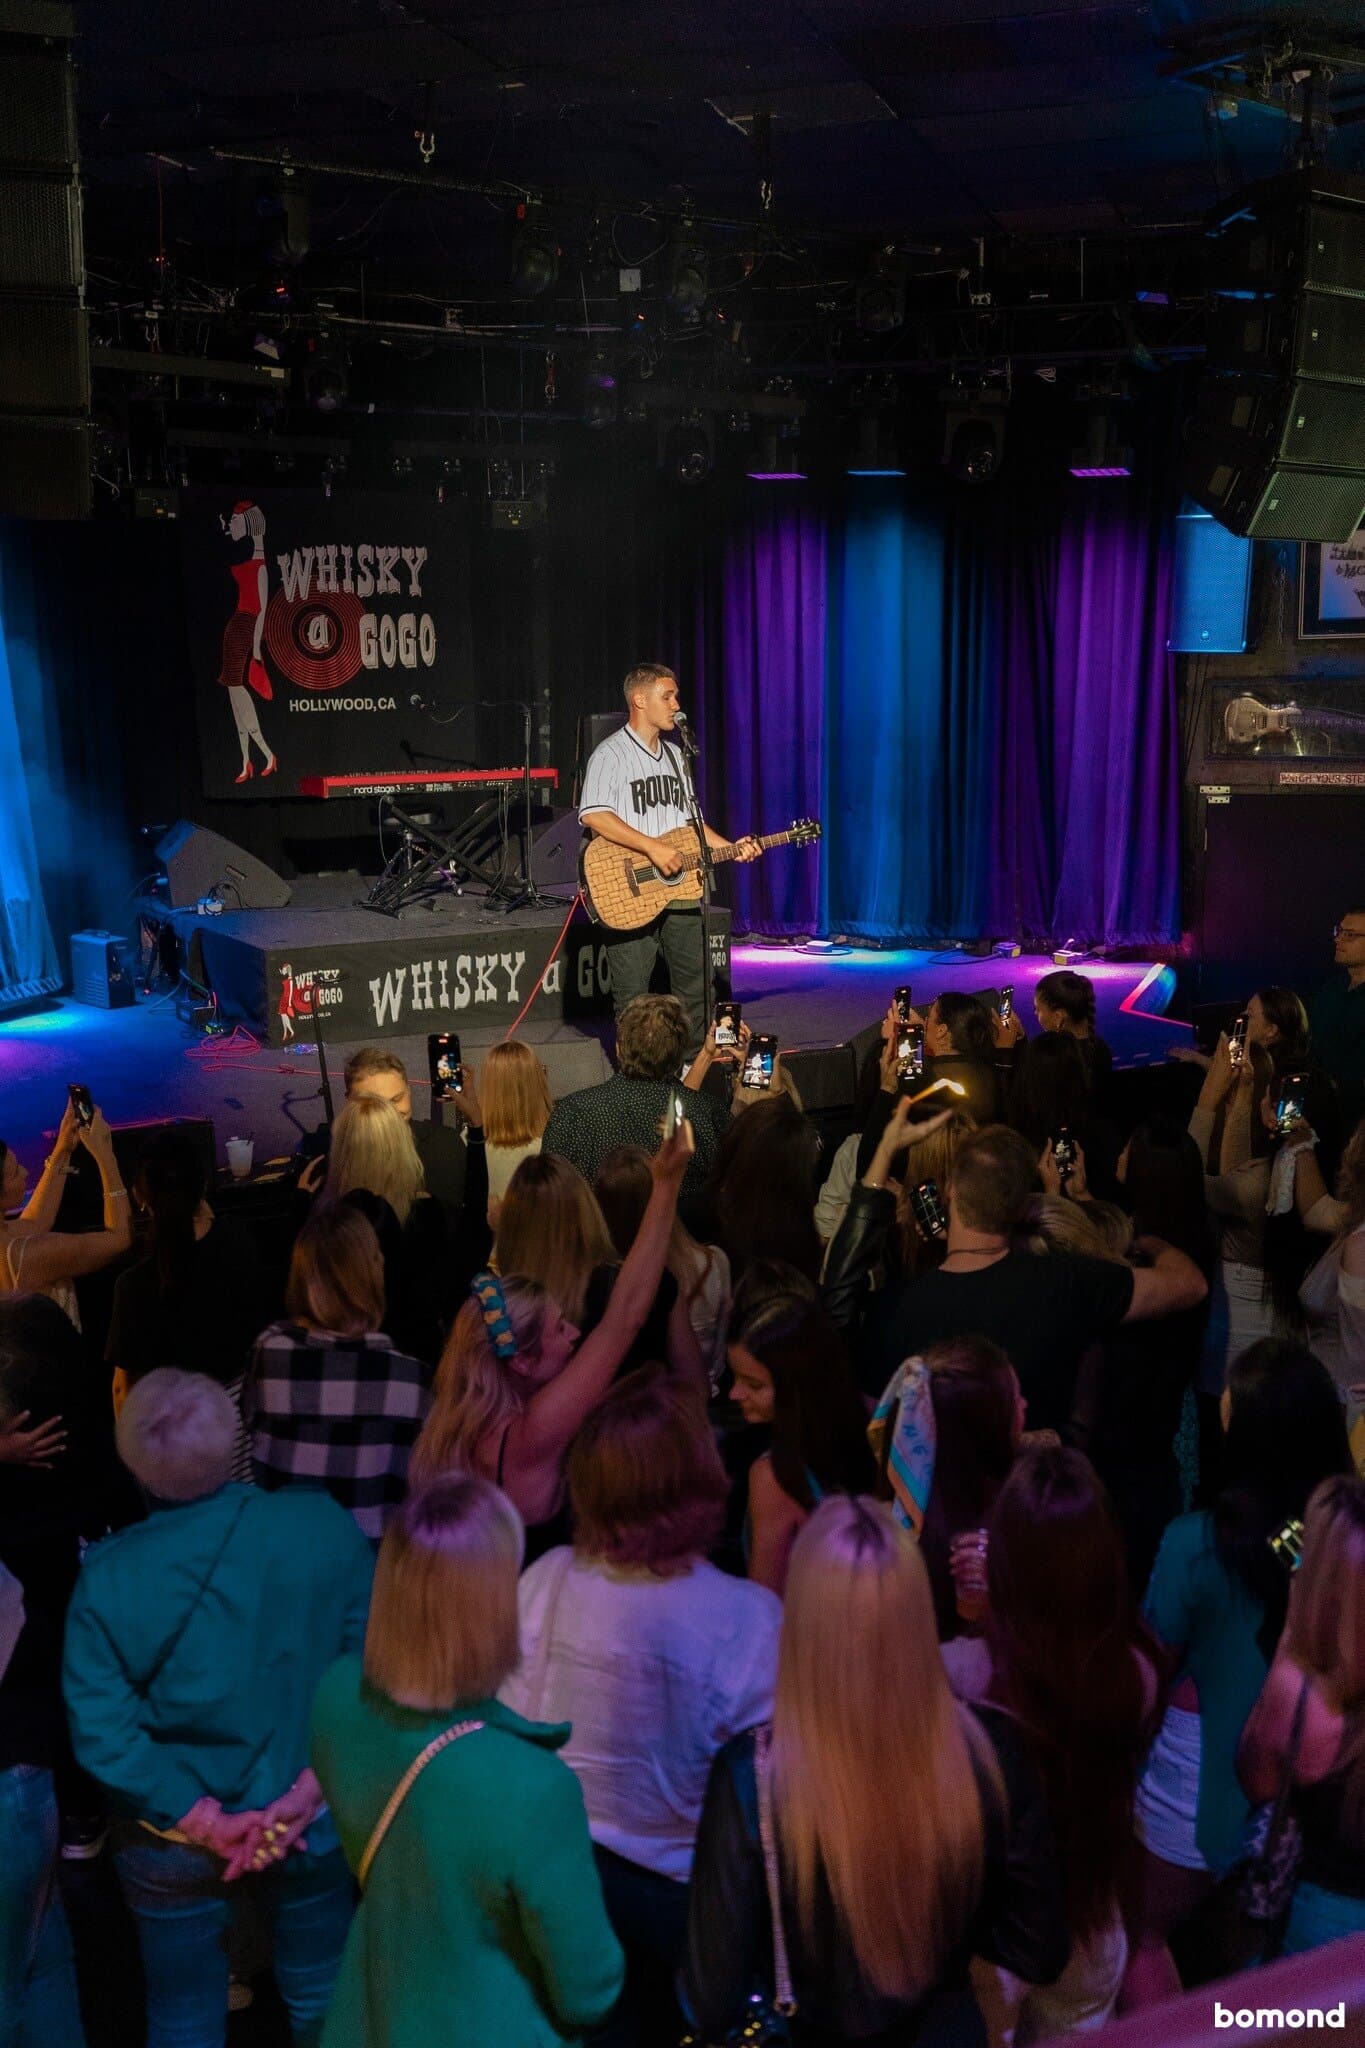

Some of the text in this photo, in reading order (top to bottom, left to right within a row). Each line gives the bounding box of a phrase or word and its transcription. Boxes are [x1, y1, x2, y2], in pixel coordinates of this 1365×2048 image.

[277, 544, 428, 603] WHISKY
[307, 612, 437, 670] a GOGO
[354, 785, 373, 795] nord
[374, 785, 396, 795] stage
[1345, 774, 1365, 784] STE
[319, 987, 343, 1006] GOGO
[369, 951, 526, 1028] WHISKY
[542, 960, 561, 995] a
